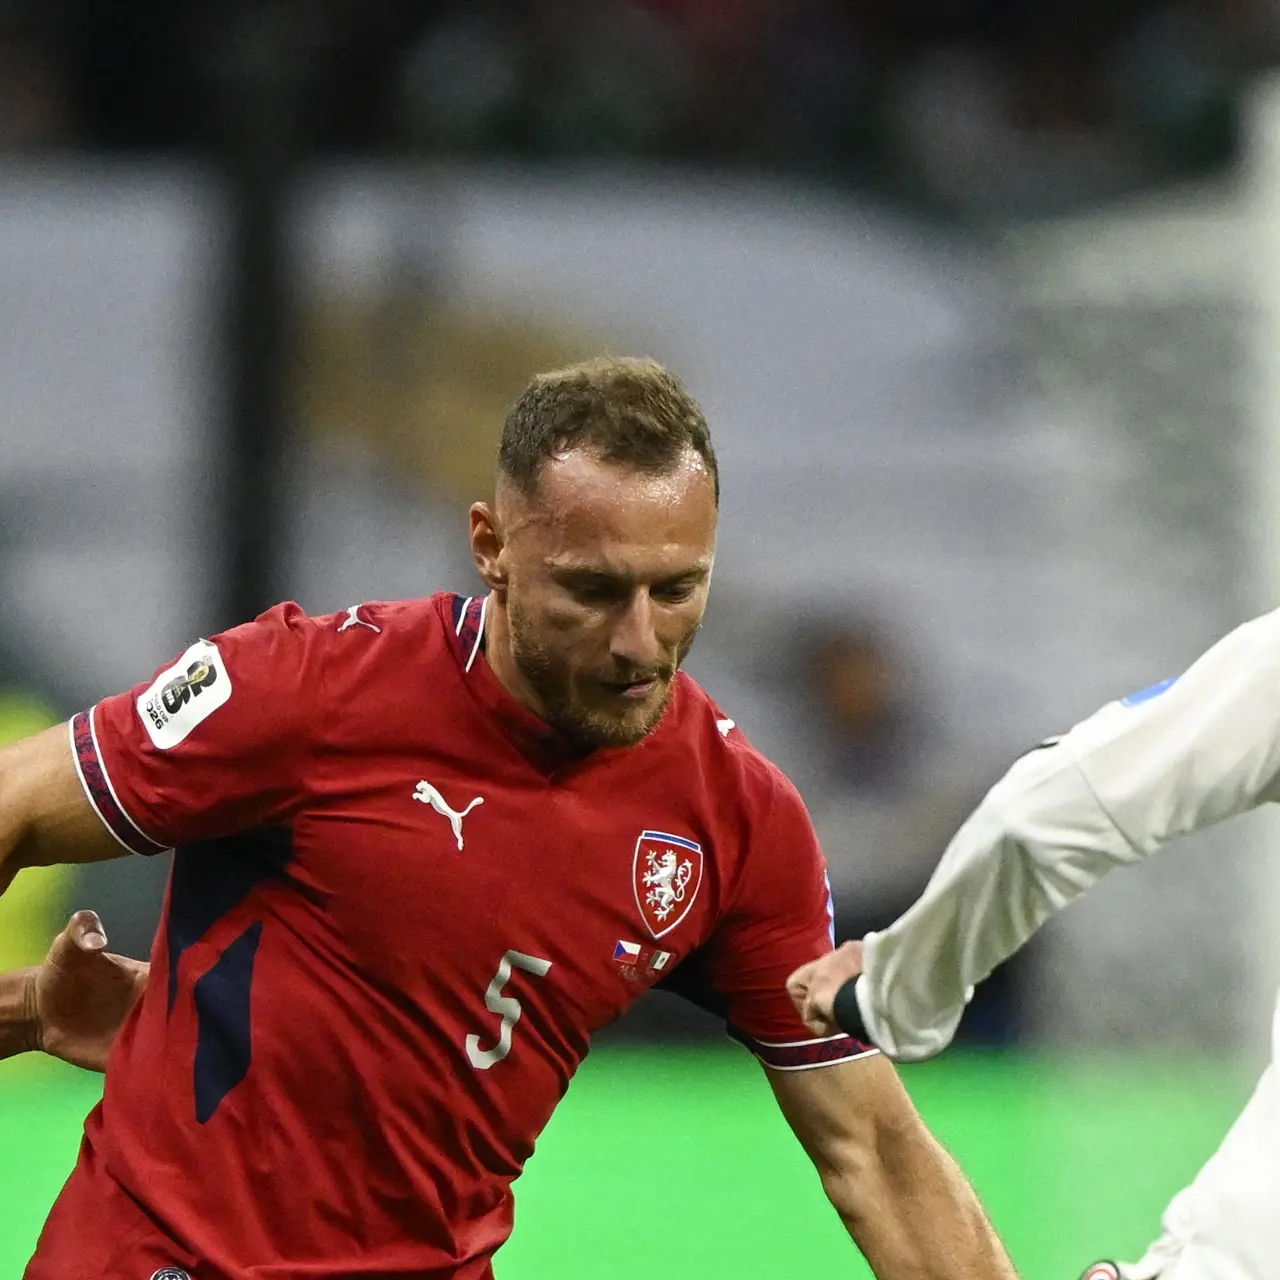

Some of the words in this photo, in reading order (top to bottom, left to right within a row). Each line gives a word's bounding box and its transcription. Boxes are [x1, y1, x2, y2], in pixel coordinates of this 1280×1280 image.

[146, 699, 164, 729] 026
[160, 710, 169, 723] CUP
[466, 949, 553, 1069] 5
